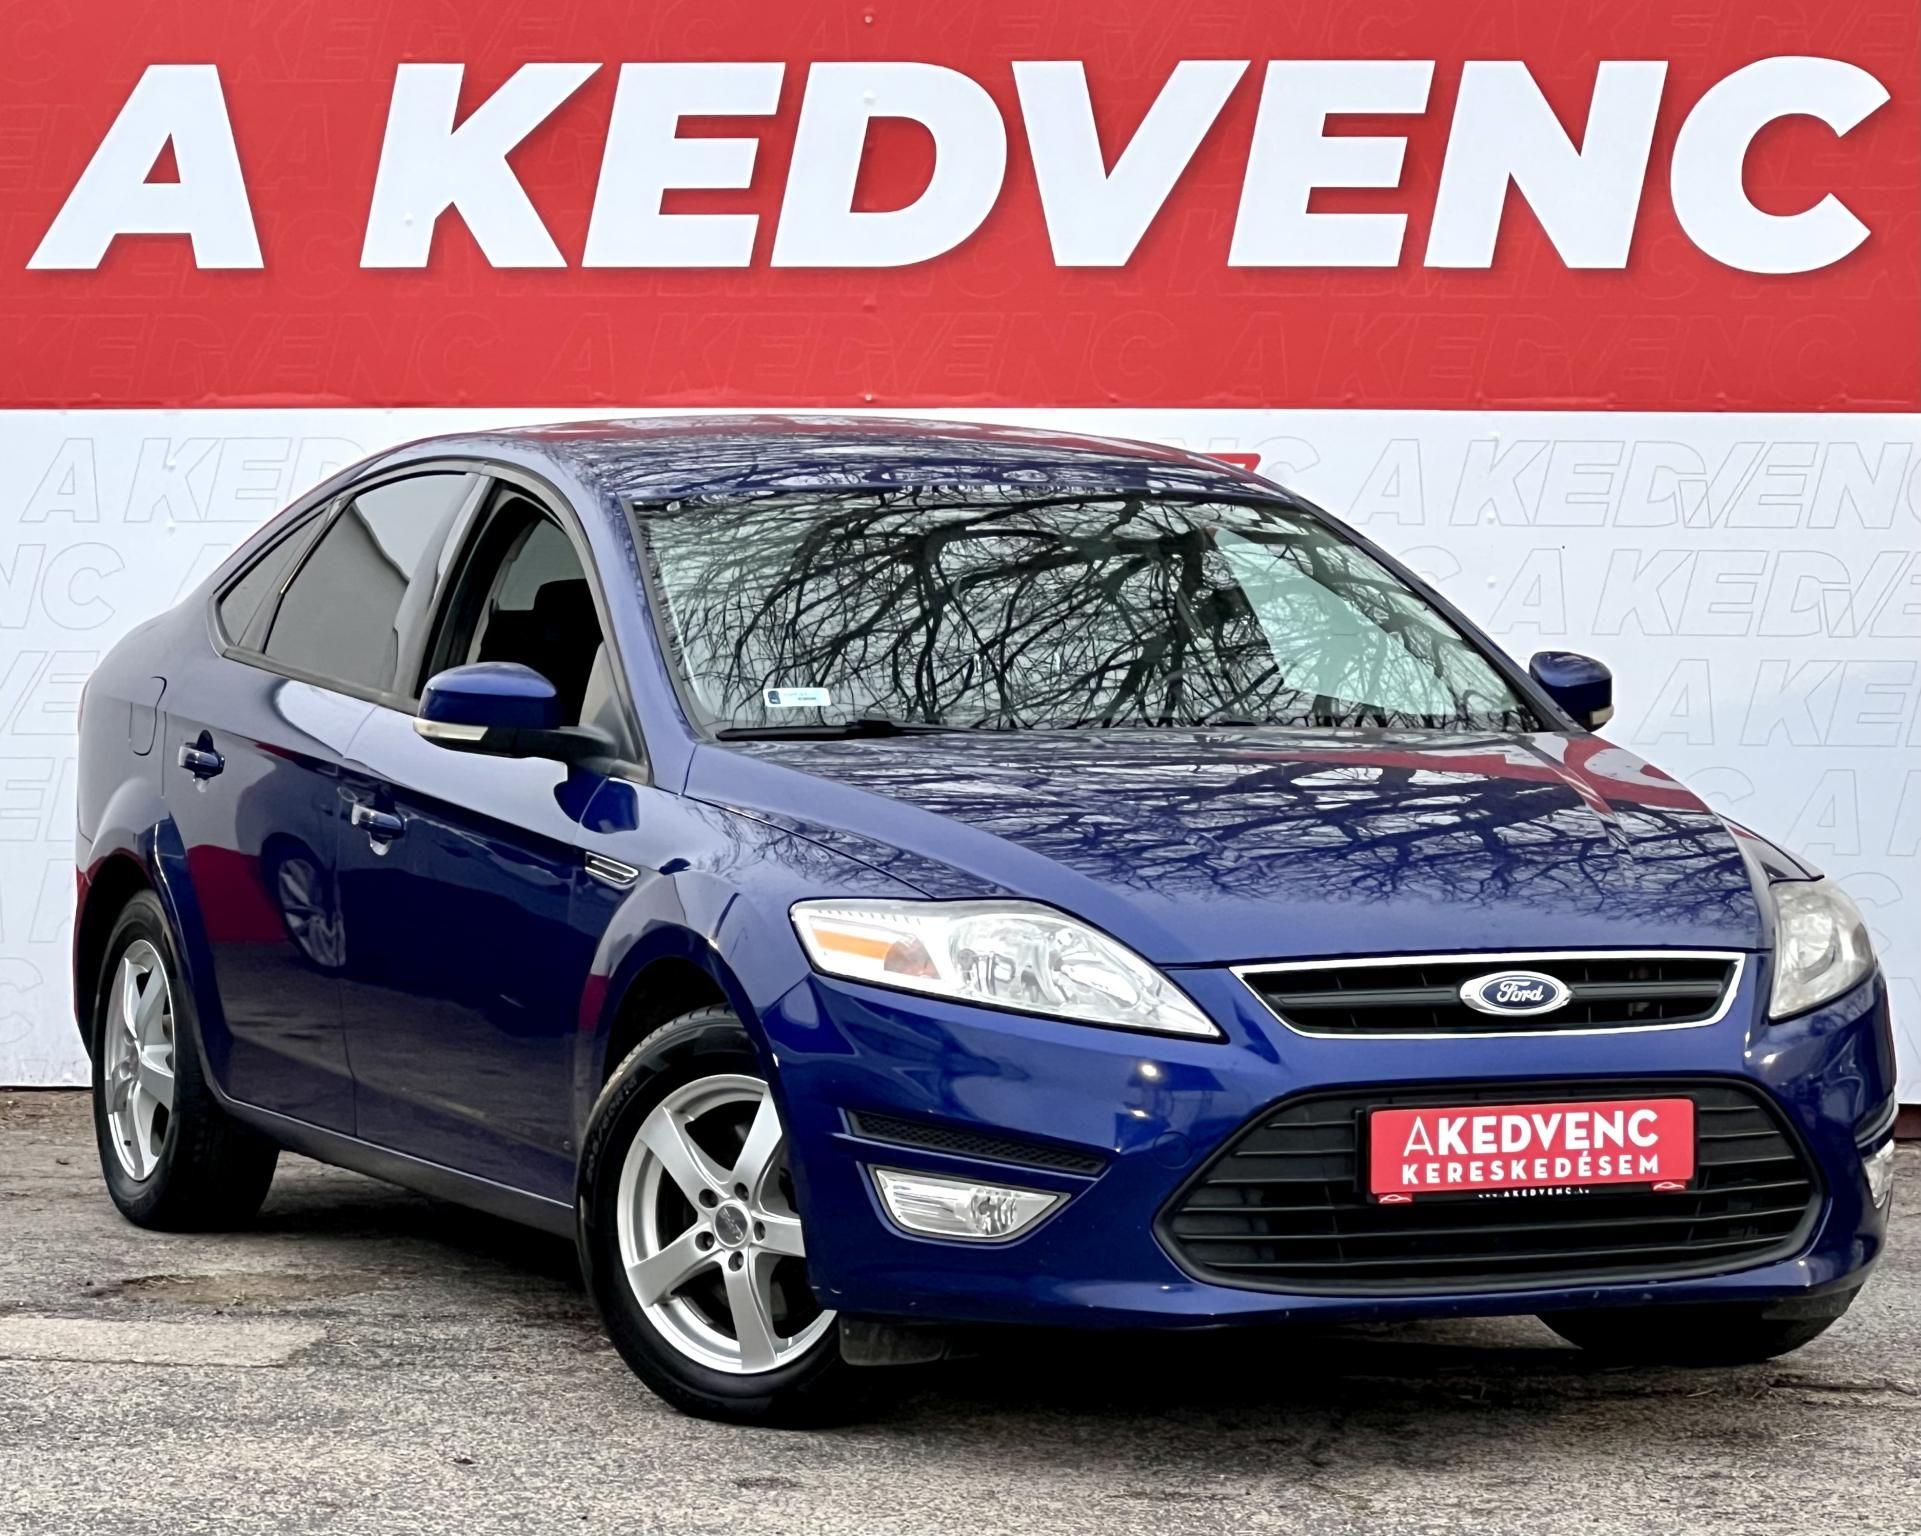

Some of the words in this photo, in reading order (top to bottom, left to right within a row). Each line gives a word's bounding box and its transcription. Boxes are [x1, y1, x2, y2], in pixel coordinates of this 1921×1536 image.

[26, 64, 264, 269] A
[360, 56, 1890, 273] KEDVENC
[1496, 980, 1544, 1003] Ford
[1401, 1150, 1660, 1185] KERESKEDÉSEM
